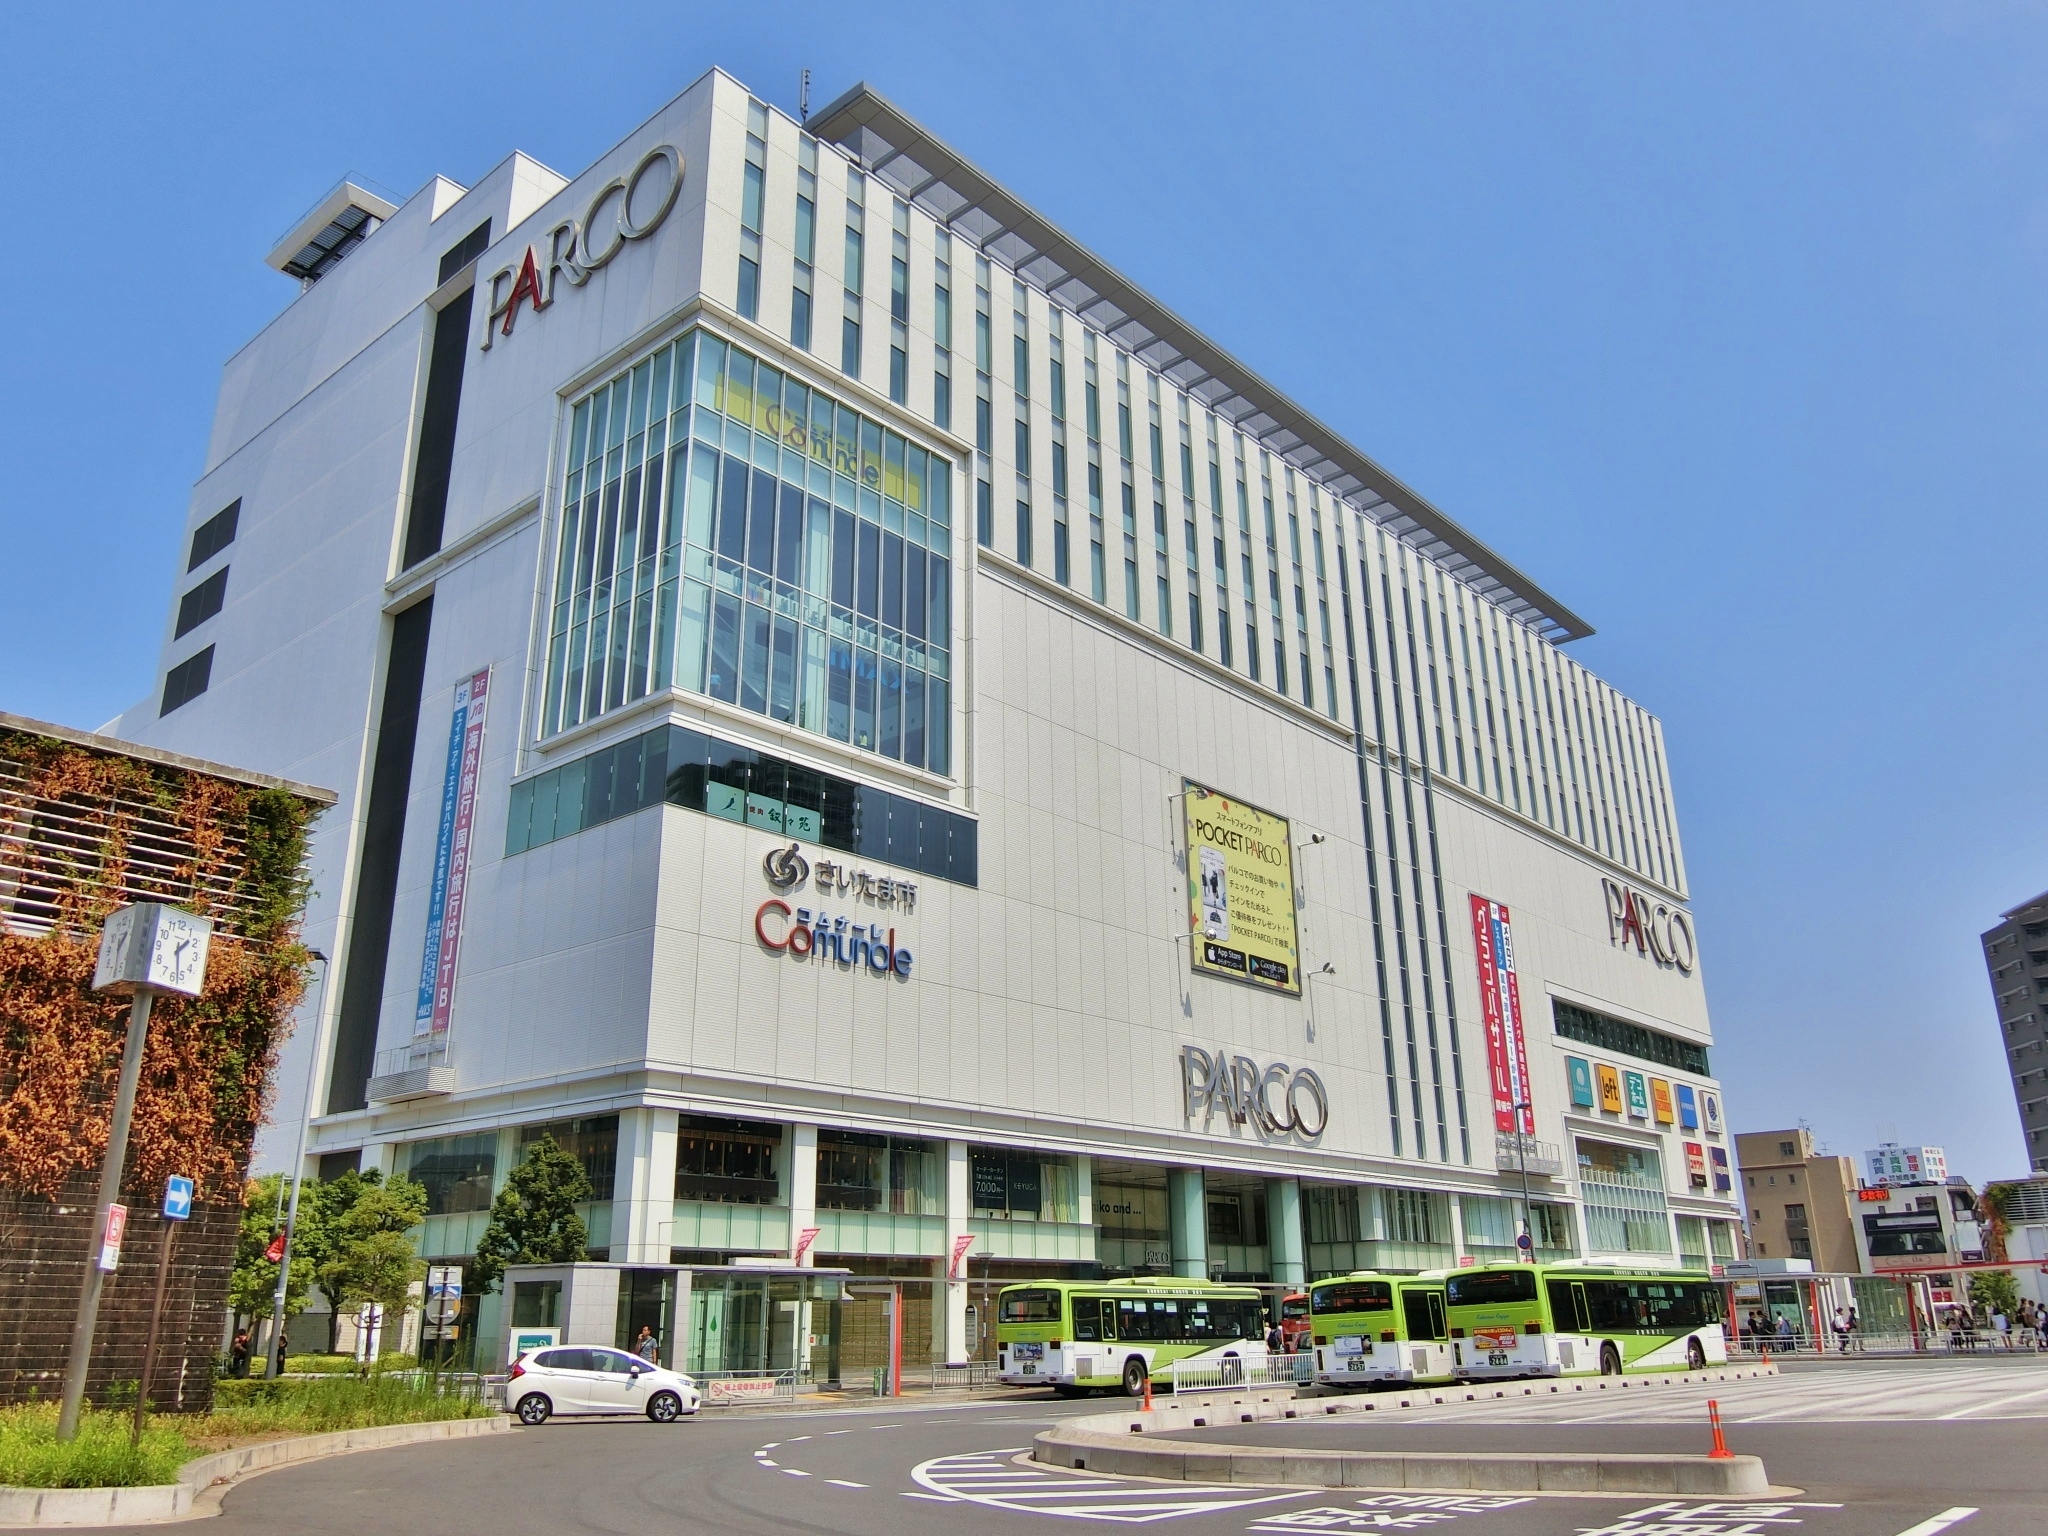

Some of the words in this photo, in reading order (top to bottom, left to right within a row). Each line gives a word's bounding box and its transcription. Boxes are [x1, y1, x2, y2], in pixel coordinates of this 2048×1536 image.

[480, 145, 685, 351] PARCO
[830, 646, 910, 694] IMAX
[475, 679, 485, 692] 2F
[457, 689, 468, 703] 3F
[768, 808, 811, 832] 叙々苑
[1216, 811, 1263, 836] スマートフォンアプリ
[1196, 819, 1244, 852] POCKET
[1246, 837, 1282, 867] PARCO
[814, 859, 918, 908] さいたま市
[1228, 865, 1279, 889] パルコでのお買い物や
[1229, 879, 1265, 899] チェックインで
[168, 921, 176, 932] 11
[177, 920, 186, 931] 12
[796, 907, 885, 940] コムナーレ
[1601, 877, 1694, 972] PARCO
[160, 928, 169, 940] 10
[189, 927, 193, 938] 1
[755, 899, 914, 977] Comunale
[155, 940, 161, 950] 9
[192, 938, 198, 948] 2
[1503, 926, 1513, 969] メガロス
[156, 954, 162, 964] 8
[192, 952, 198, 962] 3
[1217, 948, 1228, 961] App
[1228, 950, 1242, 961] Store
[162, 965, 168, 976] 7
[187, 964, 193, 973] 4
[1260, 960, 1276, 973] Google
[170, 972, 176, 982] 6
[179, 970, 185, 981] 5
[1477, 905, 1508, 1093] グランバザール
[1629, 1076, 1642, 1090] デコ
[1182, 1044, 1329, 1137] PARCO
[1631, 1090, 1645, 1105] ホーム
[1013, 1182, 1037, 1191] KEYUCA
[1113, 1201, 1131, 1215] and
[1146, 1250, 1170, 1264] PARCO
